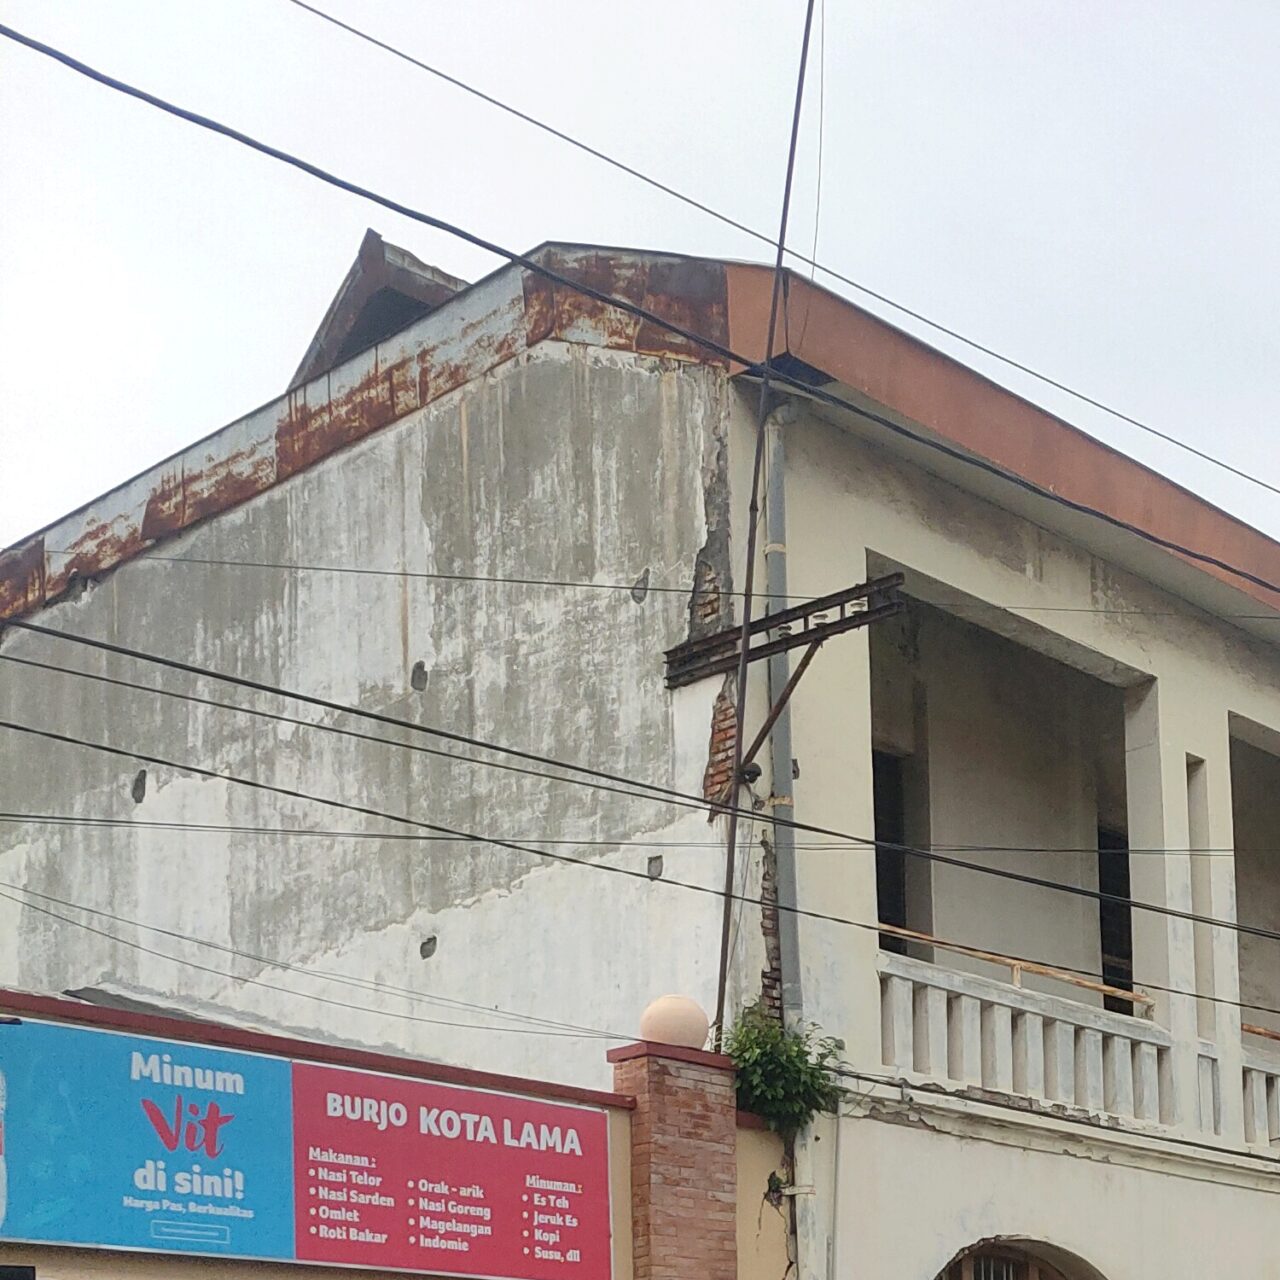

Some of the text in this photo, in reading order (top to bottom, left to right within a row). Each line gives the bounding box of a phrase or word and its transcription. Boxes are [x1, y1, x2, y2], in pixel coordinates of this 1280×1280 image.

[130, 1051, 245, 1095] Minum
[141, 1095, 236, 1160] Vit
[326, 1093, 583, 1156] BURJO KOTA LAMA
[308, 1146, 370, 1168] Makanan
[133, 1160, 245, 1200] di sini!
[318, 1167, 383, 1187] Nasi Telor
[526, 1174, 576, 1193] Minuman
[318, 1186, 395, 1207] Nasi Sarden
[418, 1179, 450, 1195] Orak
[459, 1184, 485, 1199] arik
[122, 1196, 160, 1212] Harga
[162, 1199, 187, 1214] Pas,
[419, 1197, 492, 1221] Nasi Goreng
[533, 1193, 570, 1209] Es Teh
[319, 1206, 361, 1222] Omlet
[533, 1210, 579, 1228] Jeruk Es
[319, 1225, 388, 1244] Roti Bakar
[419, 1216, 493, 1238] Magelangan
[534, 1228, 561, 1246] Kopi
[419, 1234, 470, 1252] Indomie
[534, 1246, 565, 1263] Susu,
